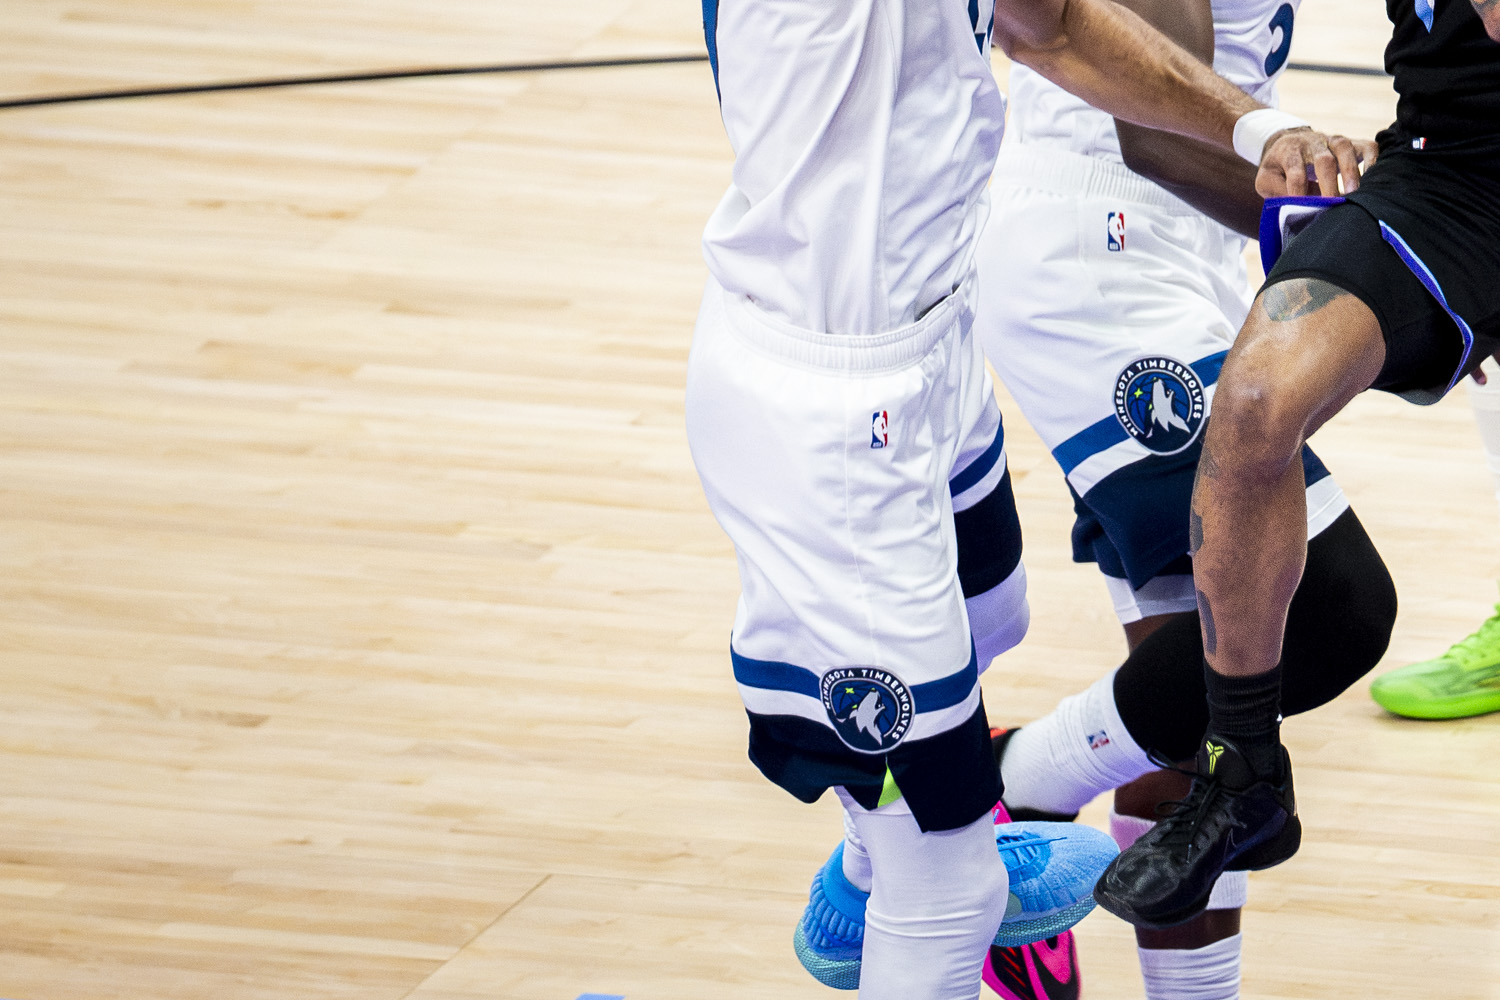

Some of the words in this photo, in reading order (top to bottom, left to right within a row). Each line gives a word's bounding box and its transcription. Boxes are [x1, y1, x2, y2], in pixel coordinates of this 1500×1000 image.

[1115, 370, 1139, 437] MINNESOTA
[1136, 359, 1203, 419] TIMBERWOLVES
[822, 669, 855, 709] MINNESOTA
[861, 668, 911, 740] TIMBERWOLVES
